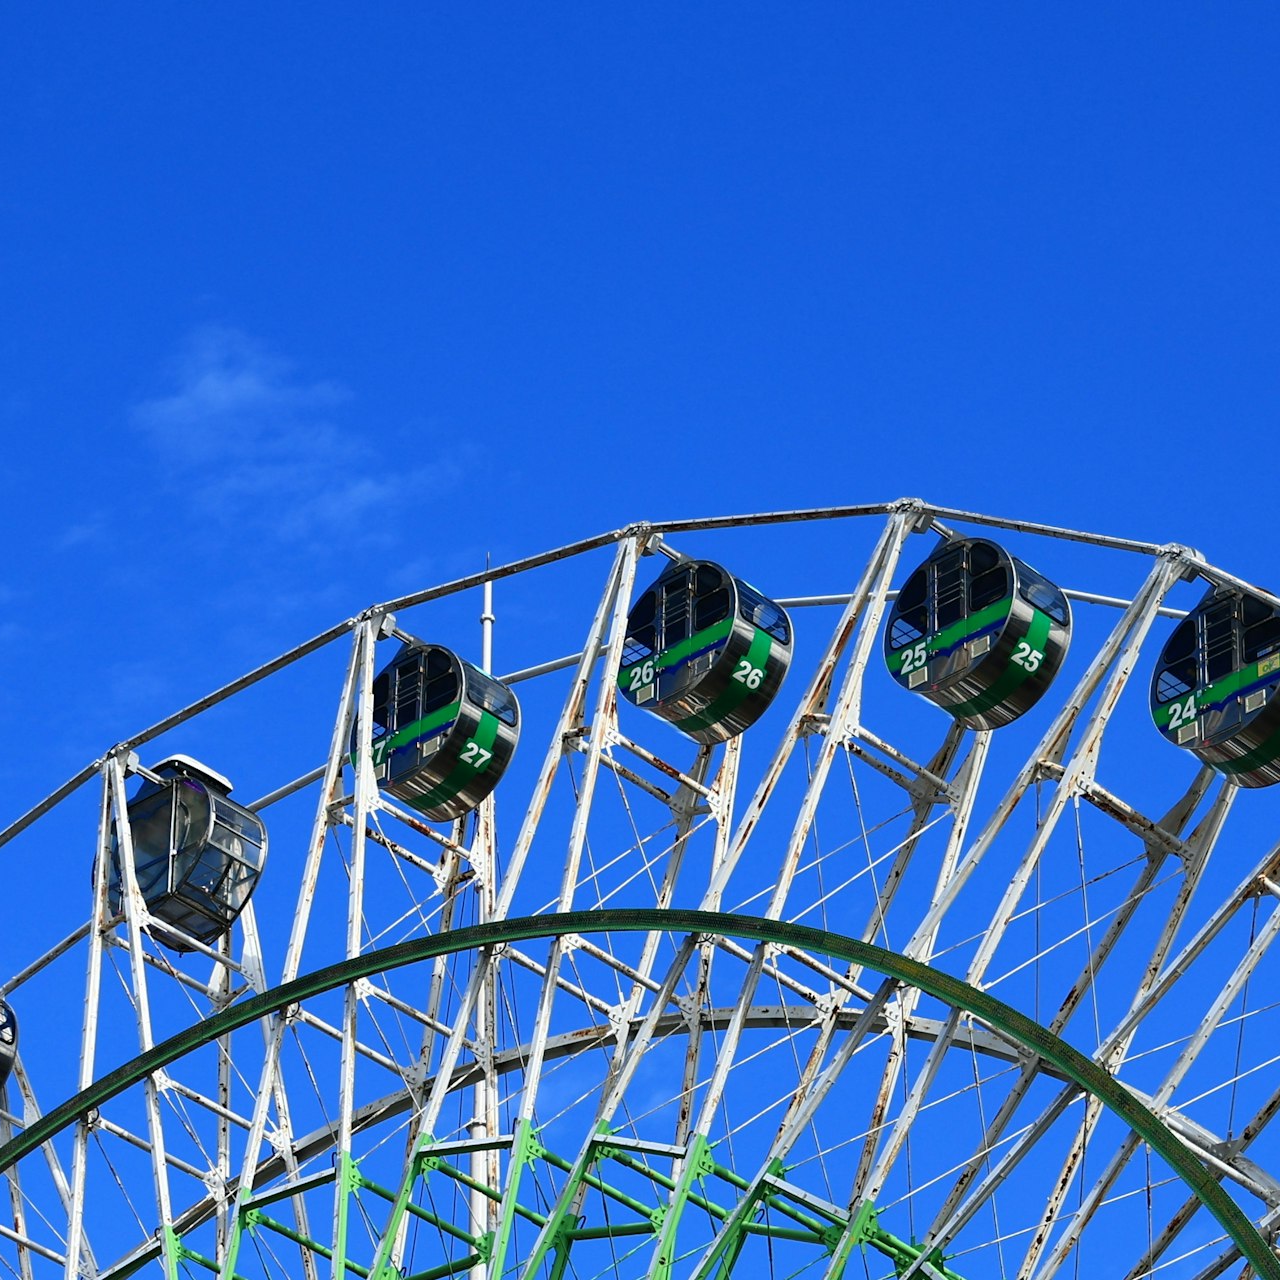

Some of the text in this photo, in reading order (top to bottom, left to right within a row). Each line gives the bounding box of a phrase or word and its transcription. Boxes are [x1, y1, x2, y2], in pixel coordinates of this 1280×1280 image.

[900, 642, 927, 675] 25
[1011, 641, 1043, 673] 25
[629, 661, 654, 691] 26
[733, 661, 762, 689] 26
[1167, 696, 1196, 730] 24
[460, 742, 491, 768] 27
